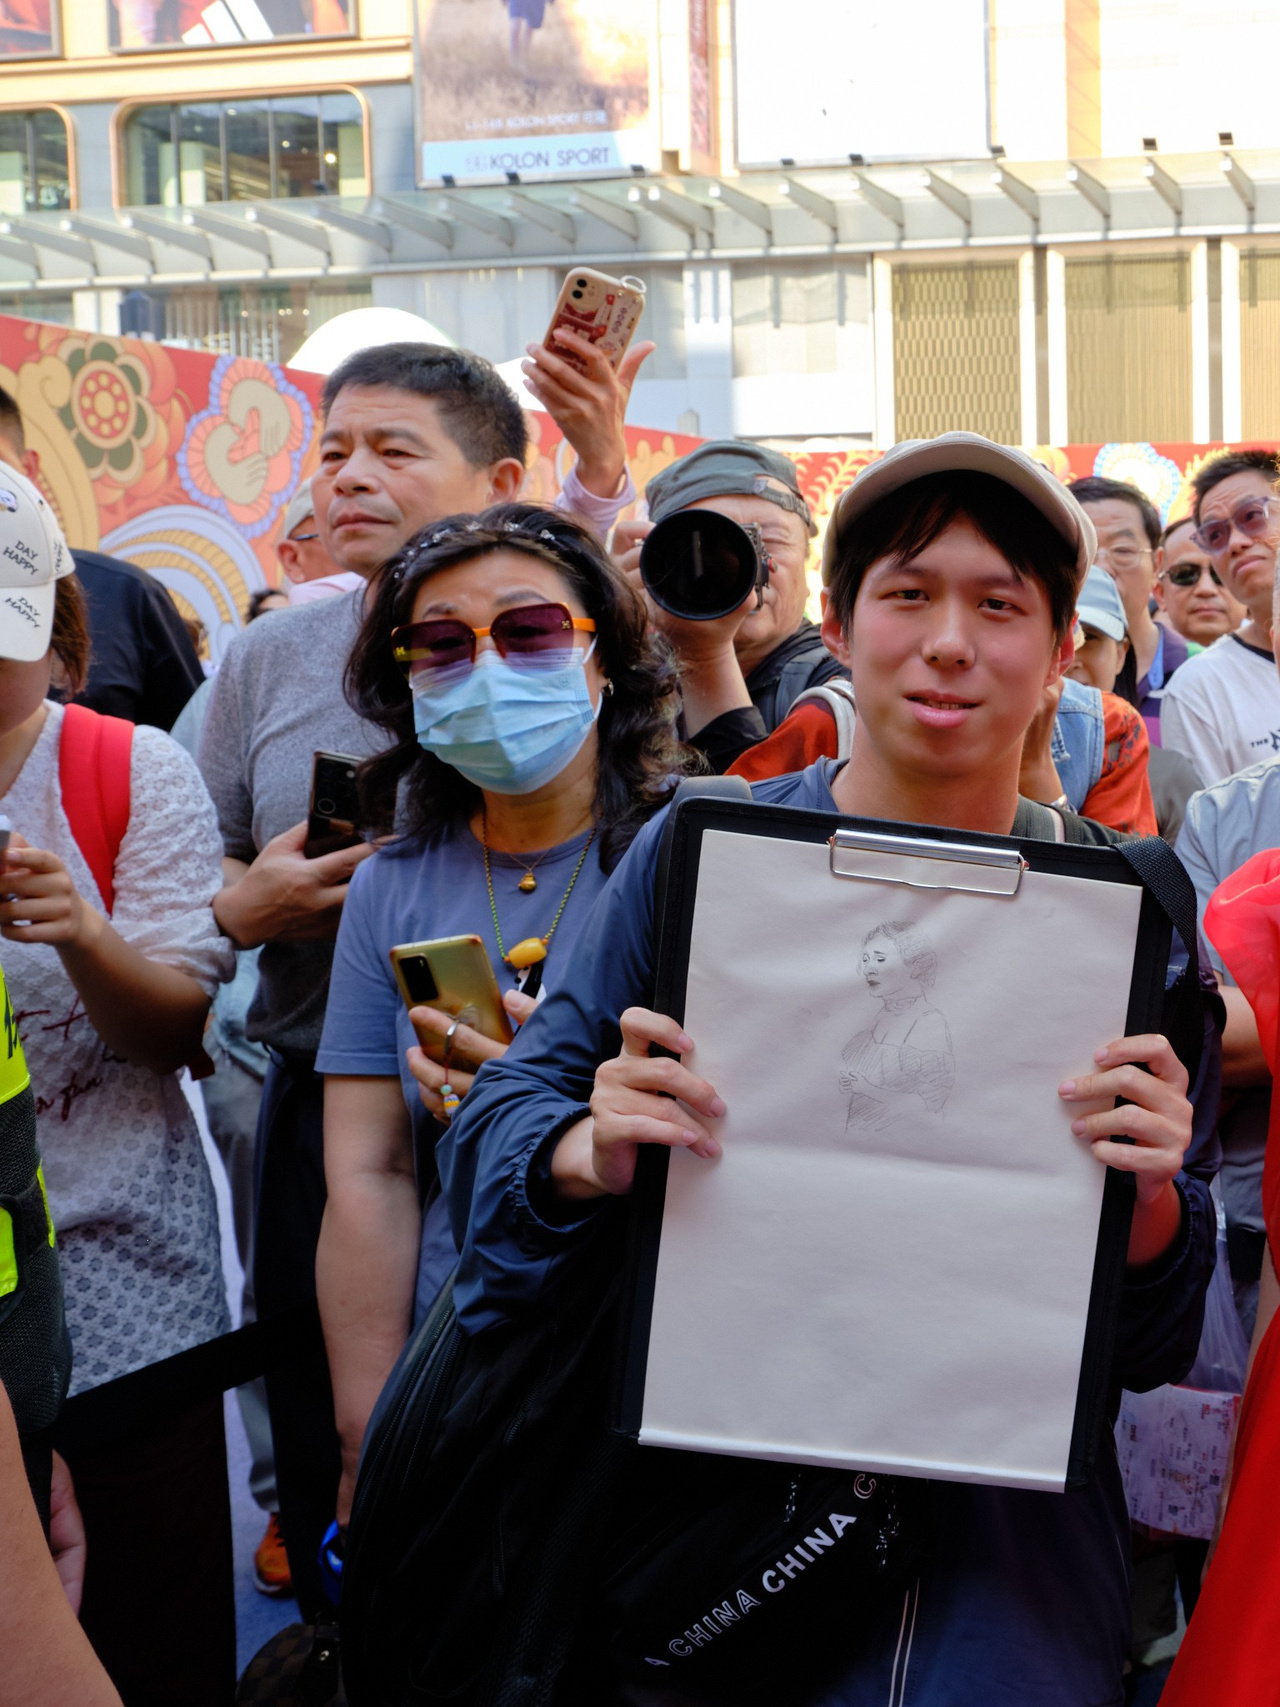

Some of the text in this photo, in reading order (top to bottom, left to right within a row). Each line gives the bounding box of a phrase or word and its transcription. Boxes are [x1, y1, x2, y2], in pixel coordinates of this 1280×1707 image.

[490, 147, 609, 170] KOLON SPORT
[3, 547, 39, 575] HAPPY
[15, 541, 39, 560] DAY
[5, 597, 40, 628] HAPPY
[19, 597, 40, 616] DAY
[668, 1512, 857, 1656] CHINA CHINA
